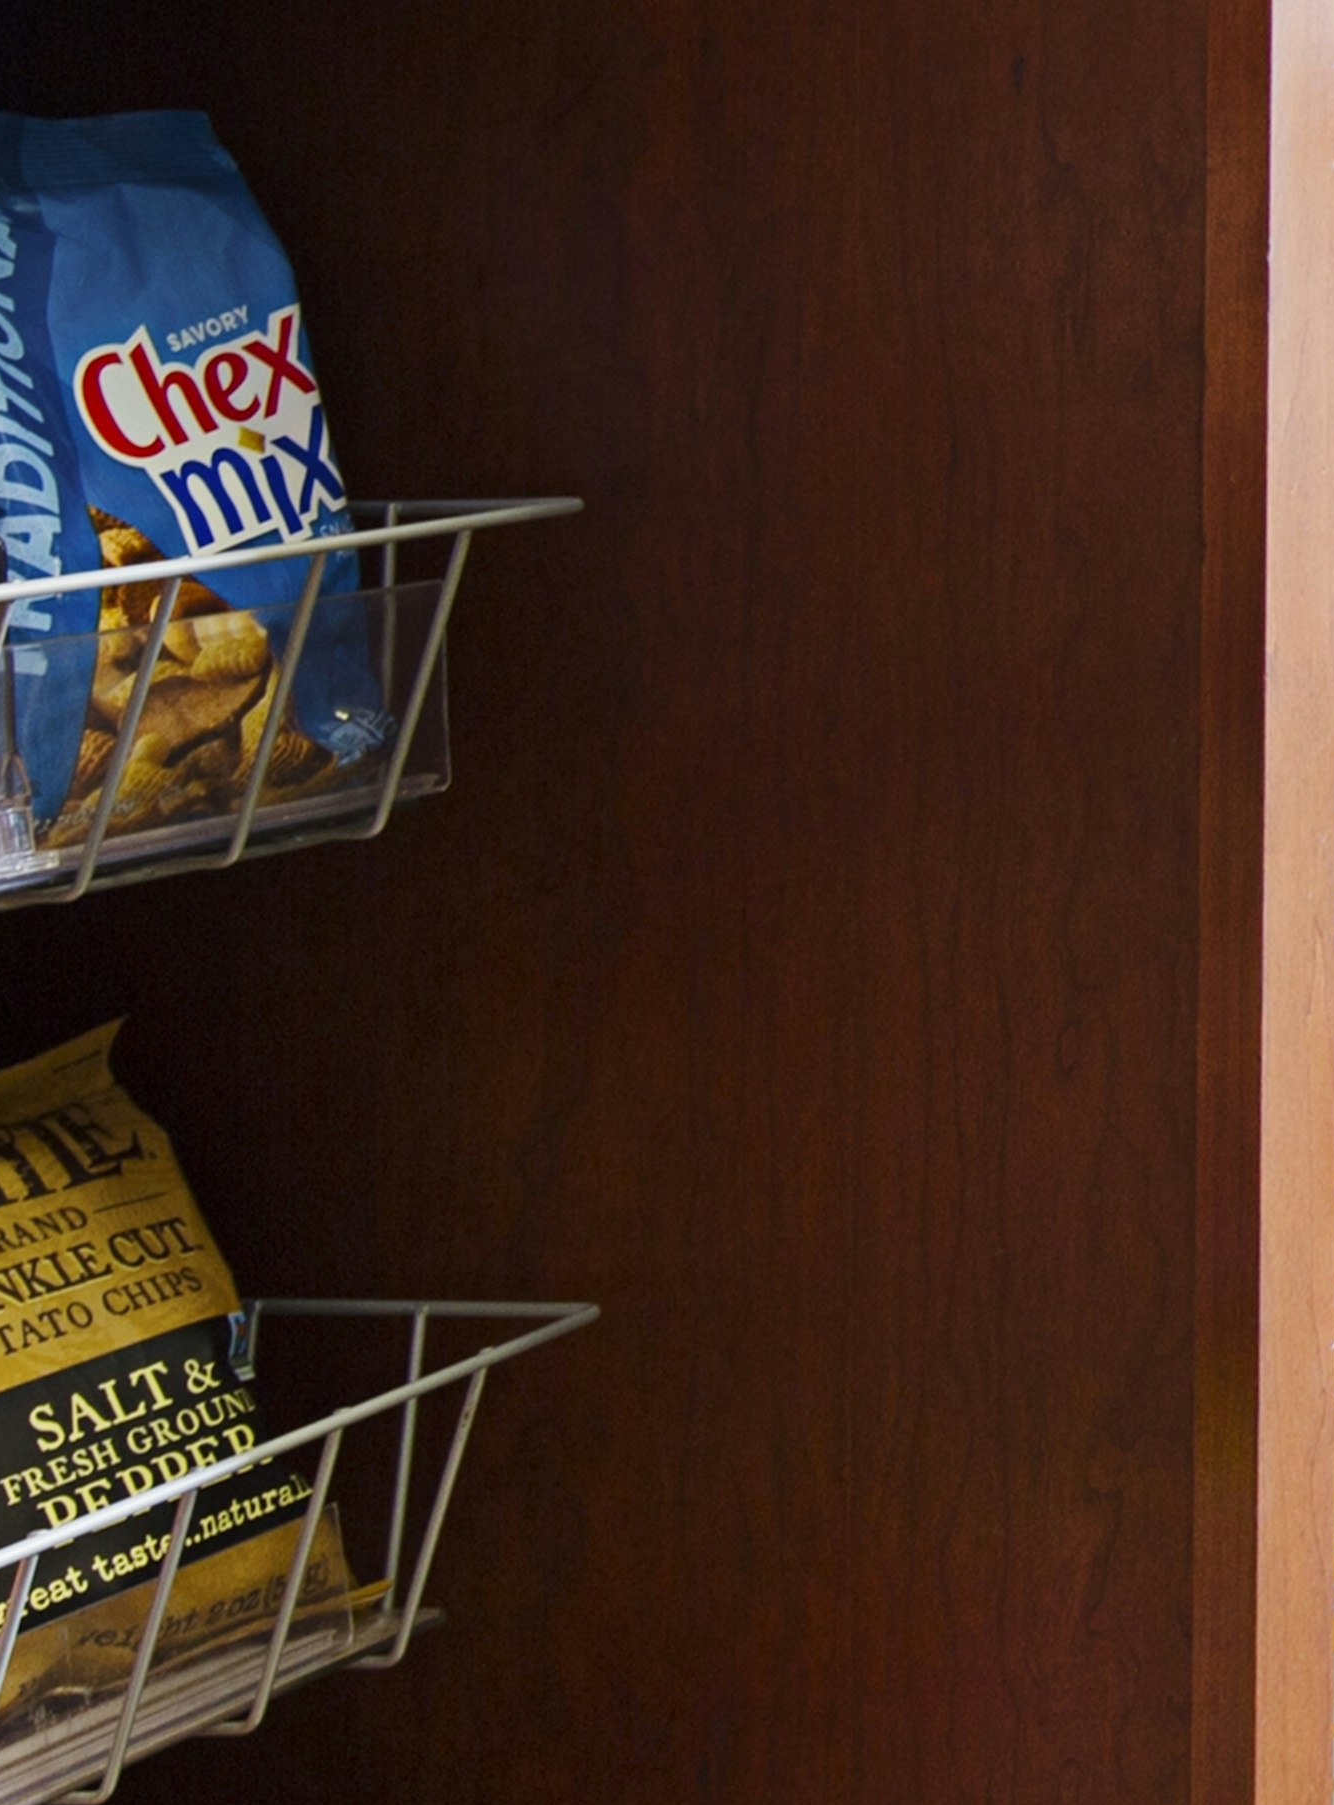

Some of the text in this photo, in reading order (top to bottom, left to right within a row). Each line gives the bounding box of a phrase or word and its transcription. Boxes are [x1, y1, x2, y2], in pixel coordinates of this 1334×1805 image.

[167, 304, 250, 354] SAVORY
[80, 315, 318, 459] Chex
[160, 403, 346, 549] mix
[107, 1215, 200, 1281] CUT
[101, 1266, 205, 1336] CHIPS
[25, 1356, 222, 1454] SALT &
